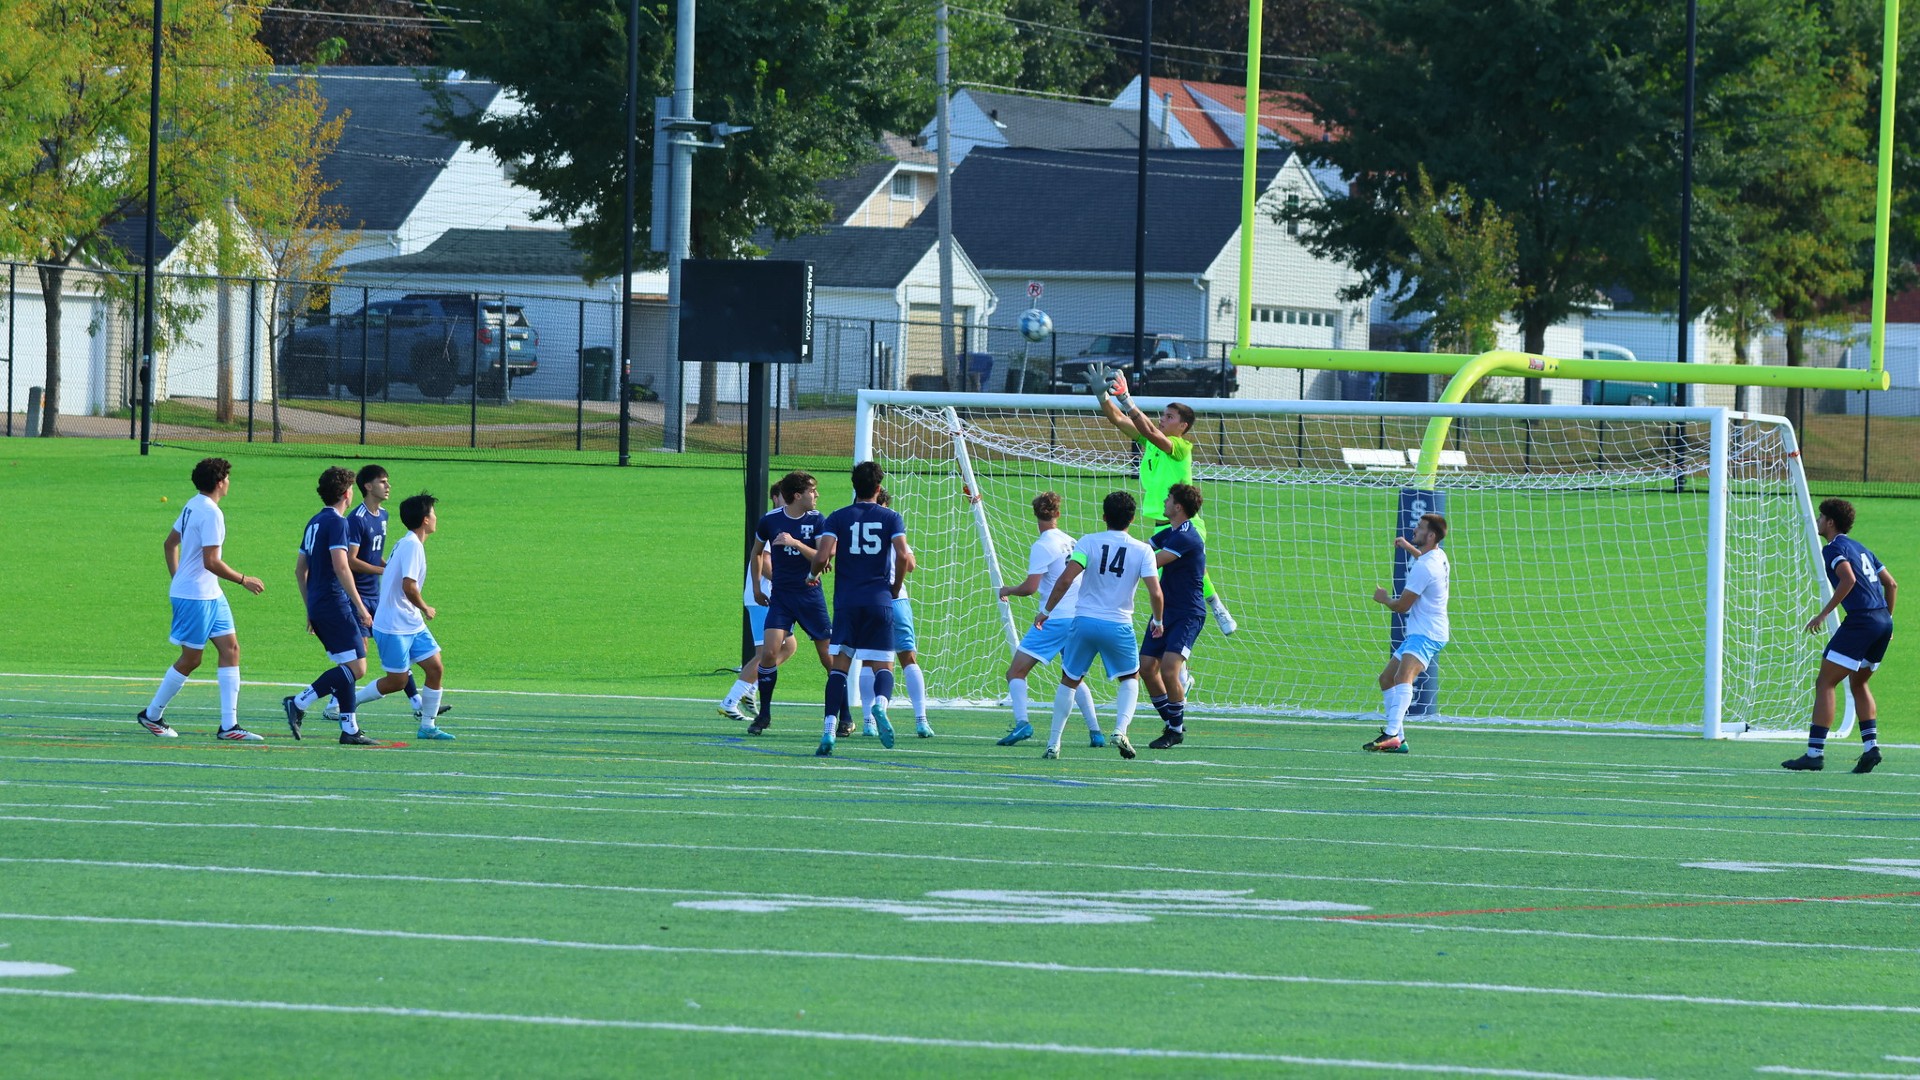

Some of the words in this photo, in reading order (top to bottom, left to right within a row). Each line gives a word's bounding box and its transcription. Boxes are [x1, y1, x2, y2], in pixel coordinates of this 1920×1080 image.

[805, 265, 813, 341] FAIR-PLAY.COM
[849, 521, 883, 555] 15
[1099, 544, 1128, 578] 14
[1860, 552, 1878, 583] 4
